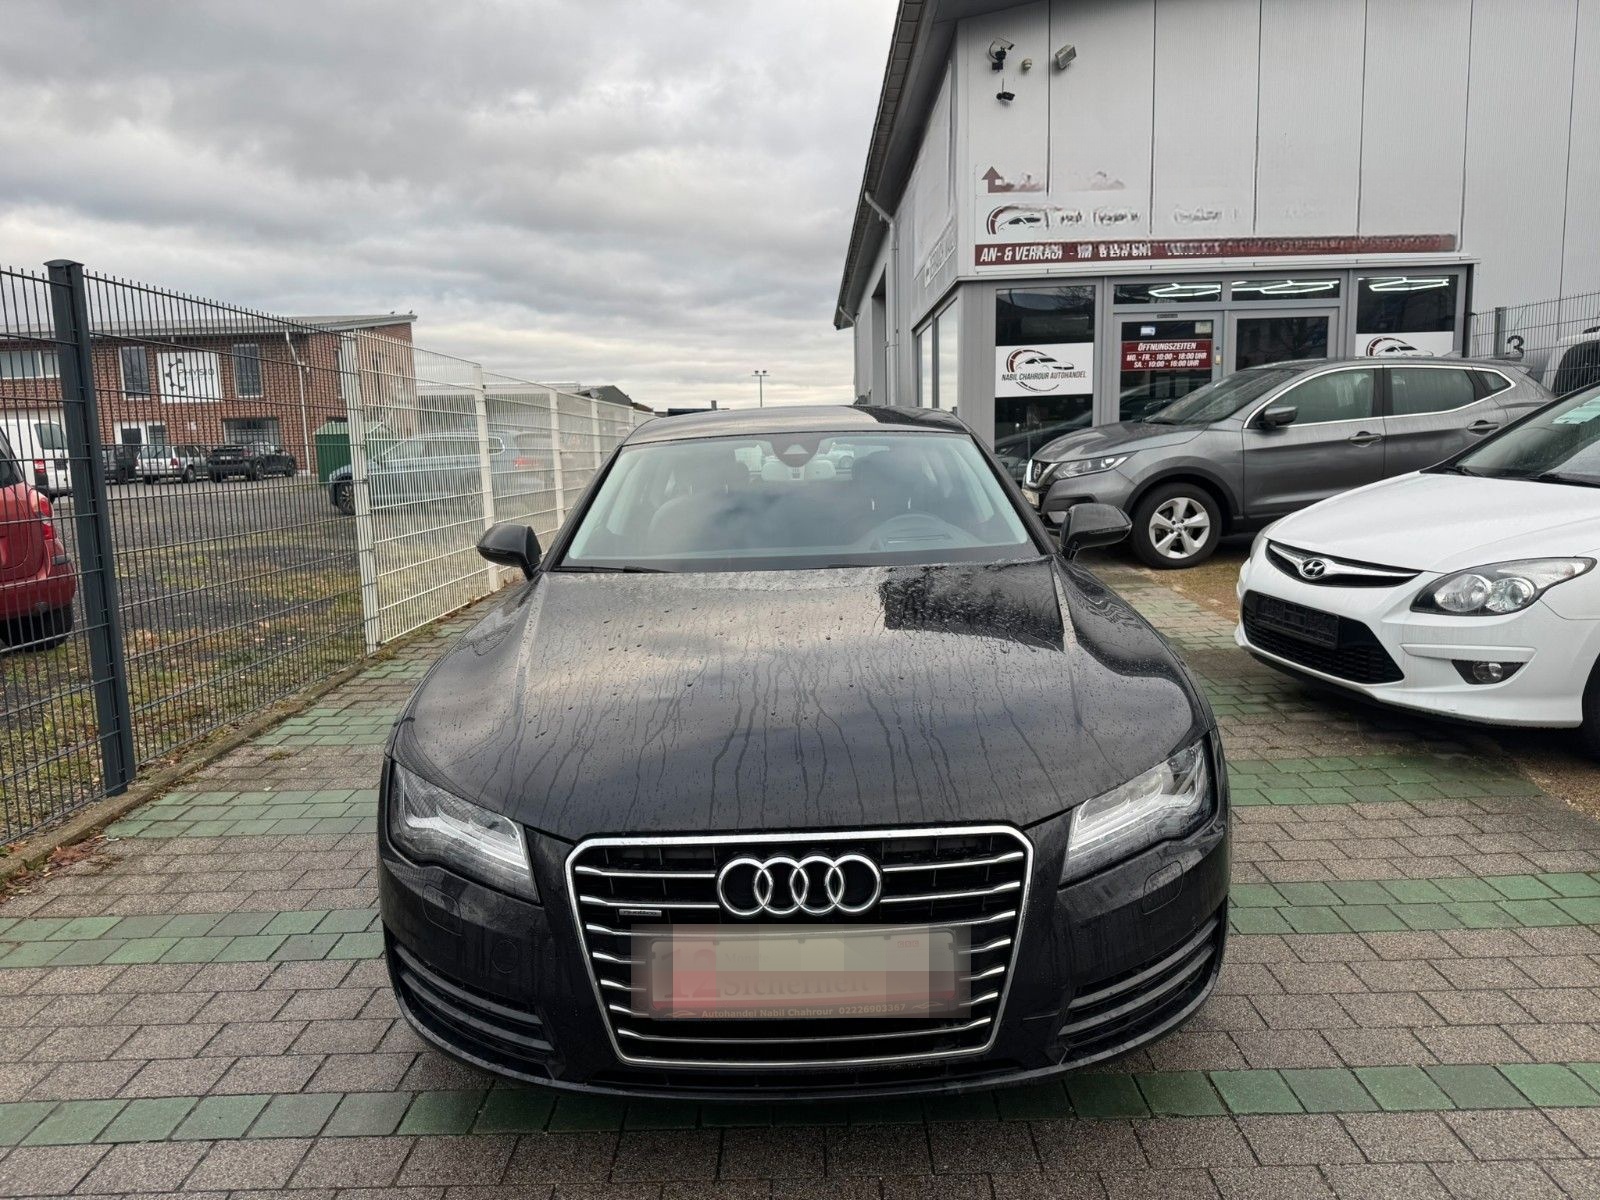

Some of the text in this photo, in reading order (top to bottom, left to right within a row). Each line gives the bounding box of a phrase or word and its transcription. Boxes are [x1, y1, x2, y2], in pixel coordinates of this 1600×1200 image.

[980, 247, 1002, 262] AN-
[1004, 247, 1013, 261] &
[1137, 342, 1197, 351] ÖFFNUNGSZEITEN
[1195, 352, 1207, 360] UHR
[1002, 371, 1086, 381] NABIL CHAHROUR AUTOHANDEL
[702, 1003, 907, 1019] Autohandel Nabil Chahrour 02226903367
